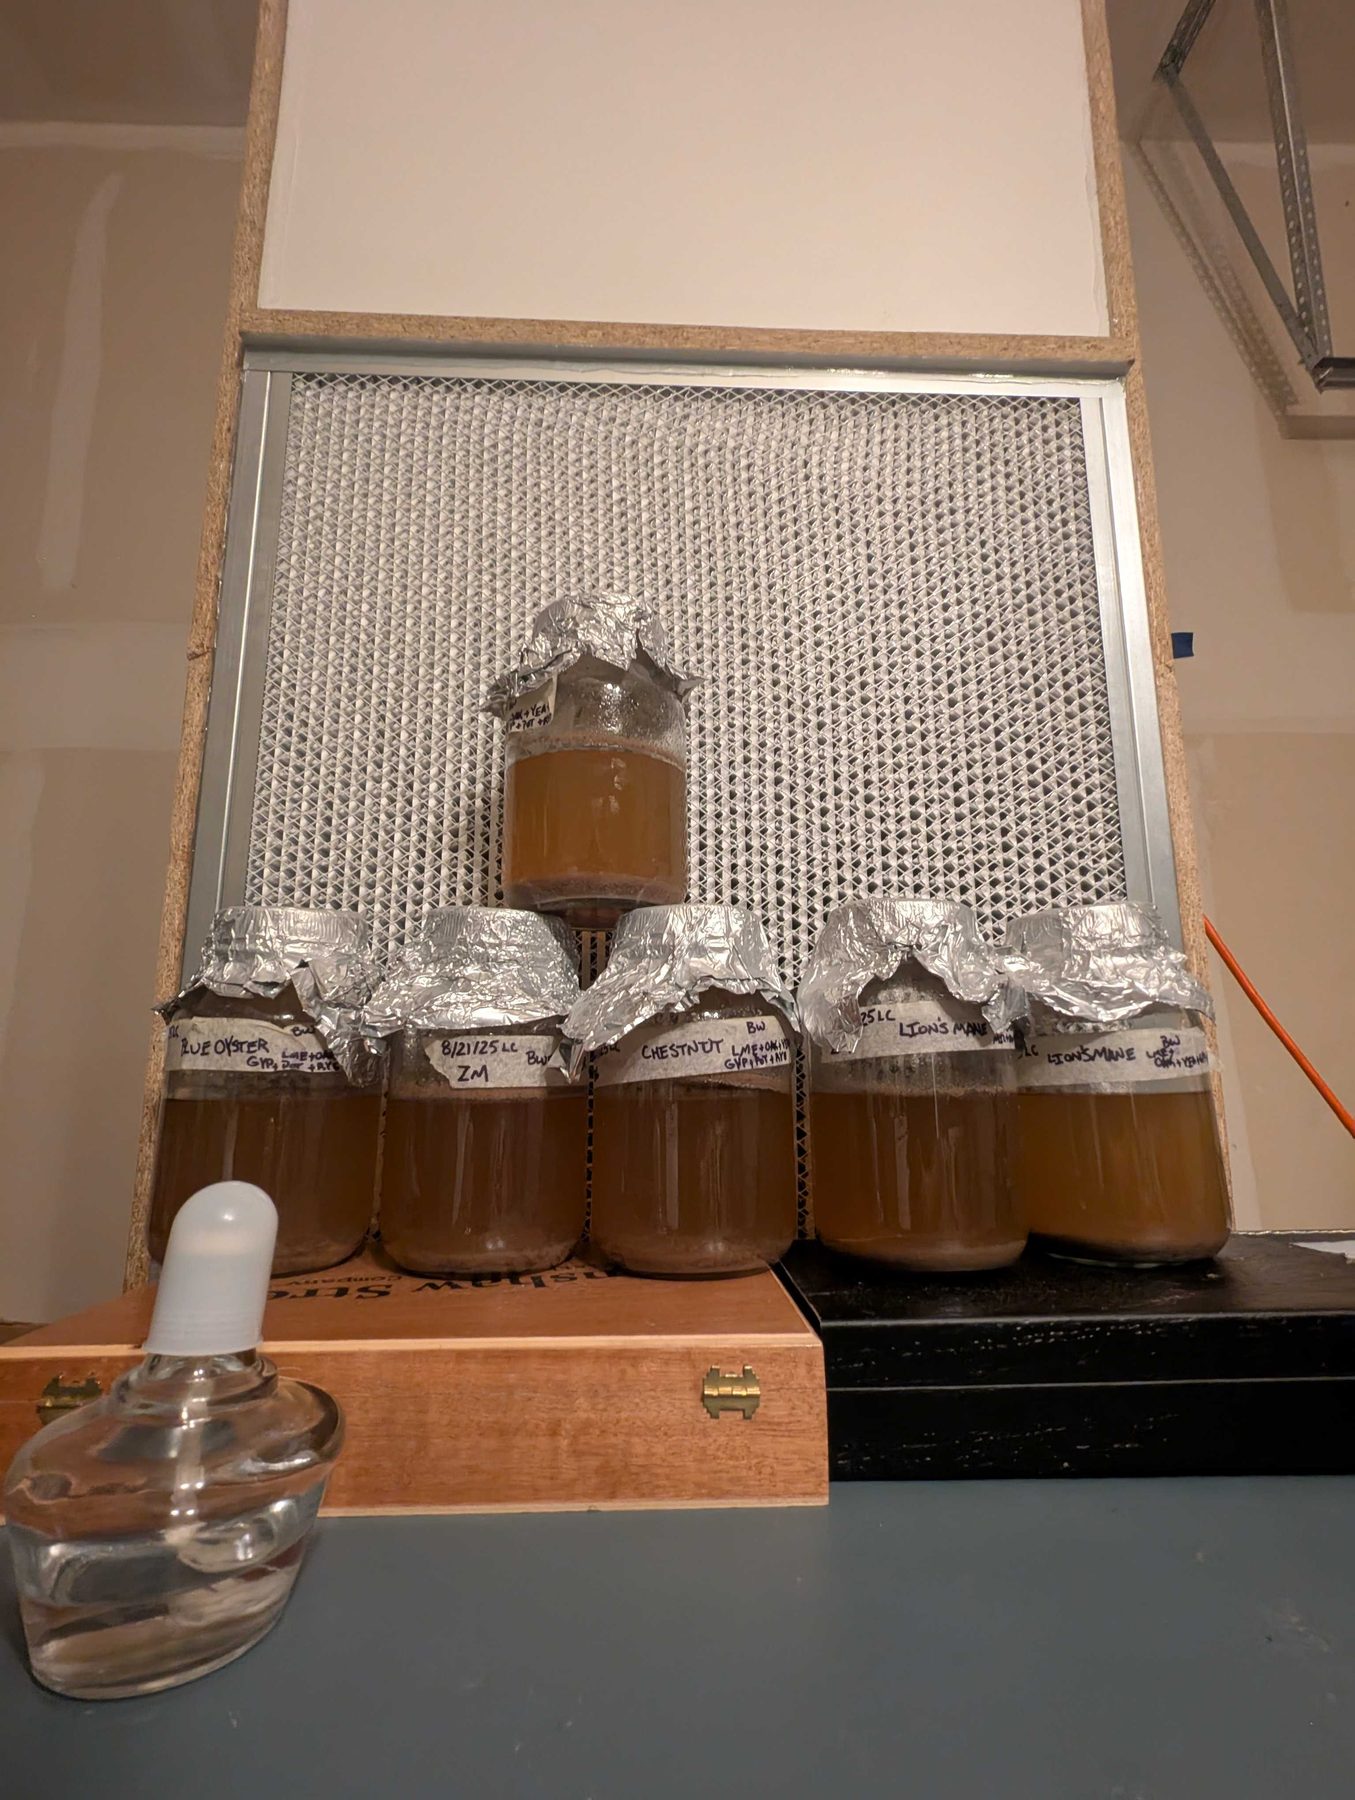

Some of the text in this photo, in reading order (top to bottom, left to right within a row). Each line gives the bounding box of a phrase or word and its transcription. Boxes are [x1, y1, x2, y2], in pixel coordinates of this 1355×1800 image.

[900, 1017, 988, 1038] LION'S MANE
[214, 1035, 269, 1057] OYSTER
[441, 1040, 499, 1059] 8/21/25
[641, 1038, 724, 1060] CHESTNUT
